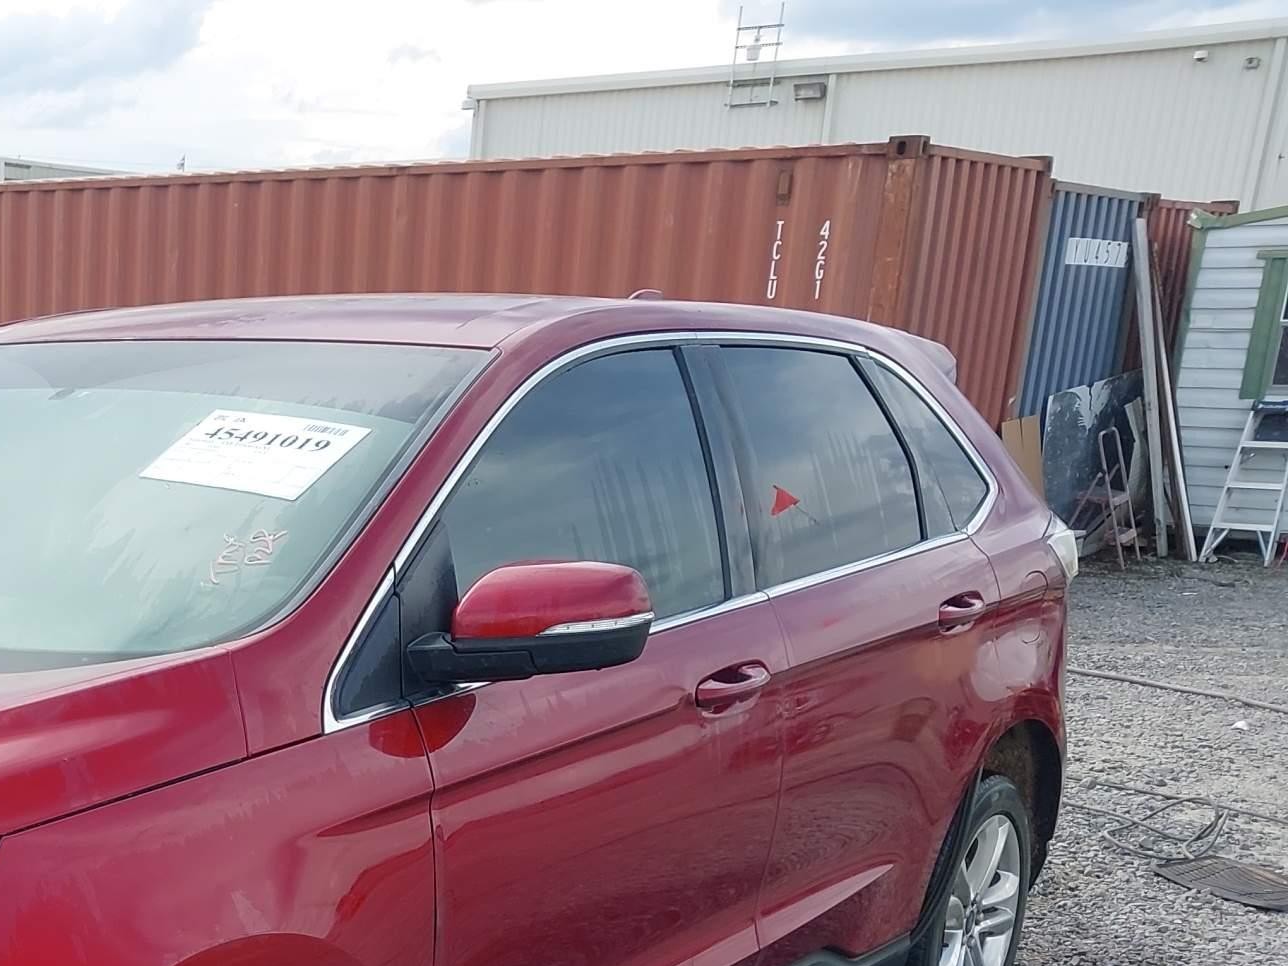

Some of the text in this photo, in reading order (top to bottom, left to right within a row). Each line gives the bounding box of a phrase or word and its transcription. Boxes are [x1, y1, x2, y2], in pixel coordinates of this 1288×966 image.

[767, 220, 785, 299] TCLU
[815, 220, 831, 299] 42G1
[205, 427, 331, 452] 45491019
